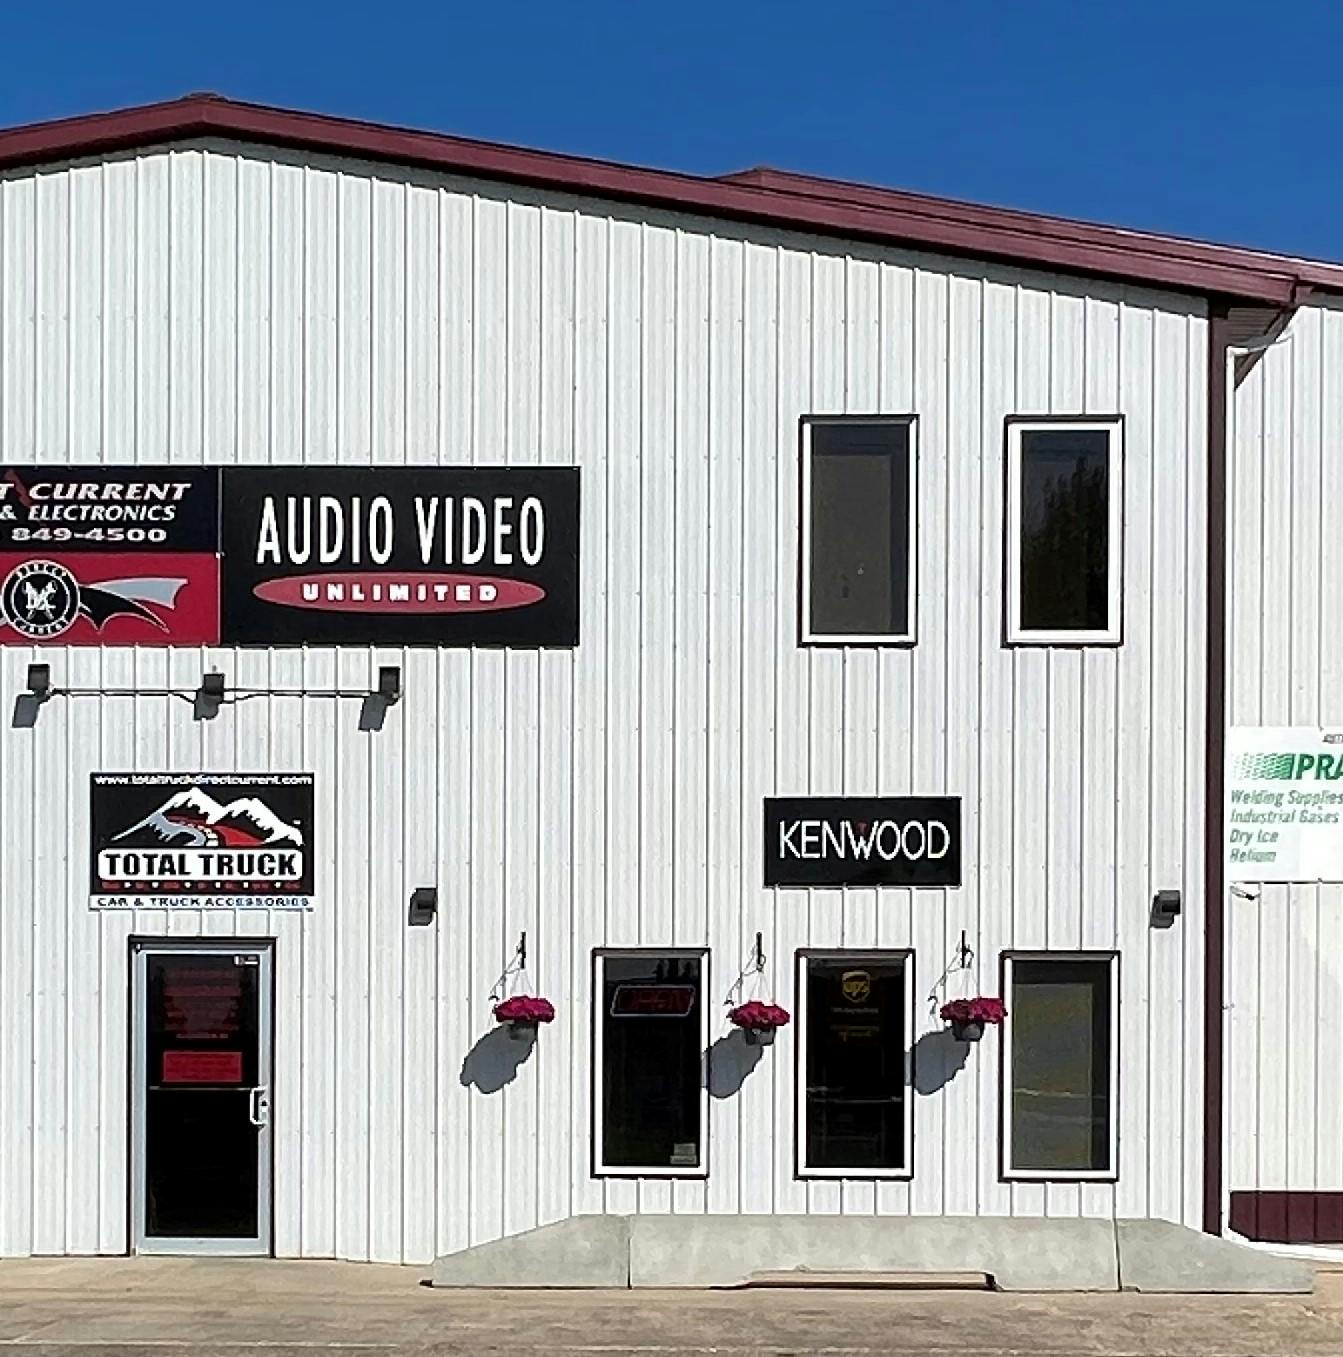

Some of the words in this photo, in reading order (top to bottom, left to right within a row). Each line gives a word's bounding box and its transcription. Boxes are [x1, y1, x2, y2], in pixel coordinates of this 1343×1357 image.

[28, 483, 192, 500] CURRENT
[27, 504, 177, 521] ELECTRONICS
[11, 527, 168, 542] 849-4500
[256, 496, 394, 565] AUDIO
[414, 496, 545, 565] VIDEO
[302, 583, 499, 602] UNLIMITED
[1230, 789, 1284, 807] Welding
[1229, 809, 1296, 825] Industrial
[1299, 810, 1340, 824] Gases
[779, 819, 951, 861] KENWOOD
[1229, 829, 1254, 846] Dry
[1257, 829, 1280, 843] Ice
[104, 853, 192, 876] TOTAL
[197, 853, 297, 876] TRUCK
[1229, 849, 1277, 864] Helium
[97, 896, 129, 907] CAR
[133, 897, 145, 907] &
[151, 897, 201, 907] TRUCK
[205, 897, 310, 908] ACCESSORIES
